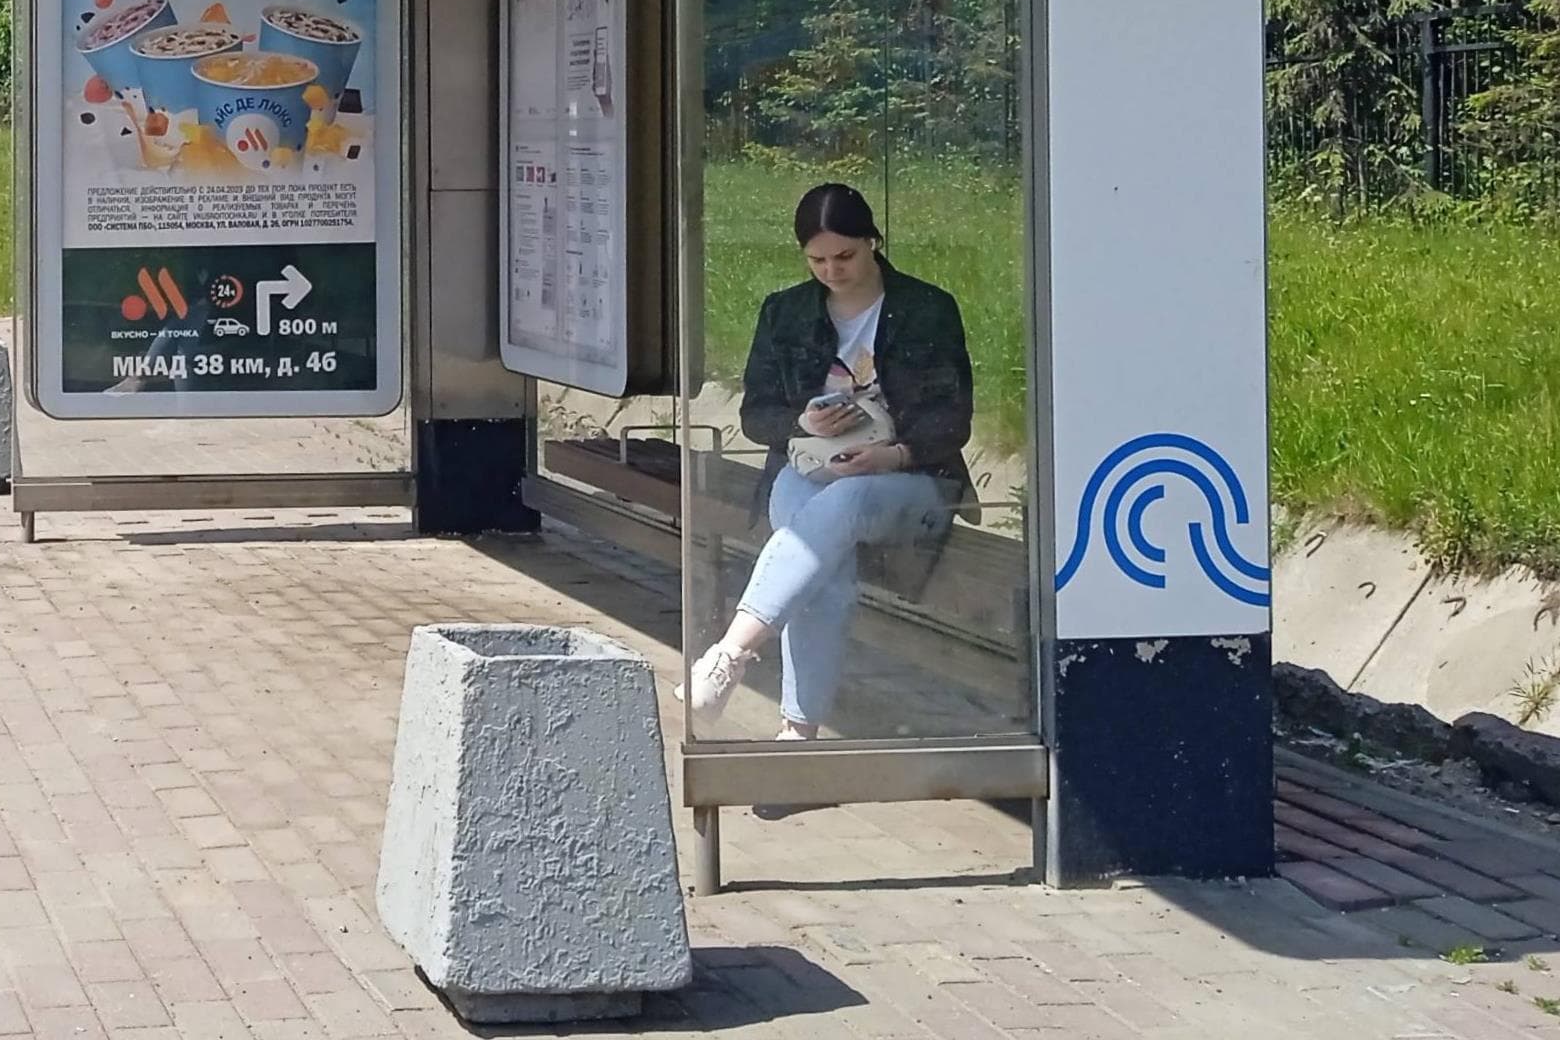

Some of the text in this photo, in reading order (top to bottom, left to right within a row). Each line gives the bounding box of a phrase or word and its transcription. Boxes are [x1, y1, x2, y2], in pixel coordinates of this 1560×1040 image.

[214, 97, 293, 128] АЙС ДЕ ЛЮКС
[111, 330, 149, 339] ВКУСНО
[167, 329, 200, 338] ТОЧКА
[278, 318, 338, 335] 800 м
[112, 355, 188, 380] МКАД
[193, 354, 224, 375] 38
[230, 357, 271, 378] км,
[277, 357, 300, 377] д.
